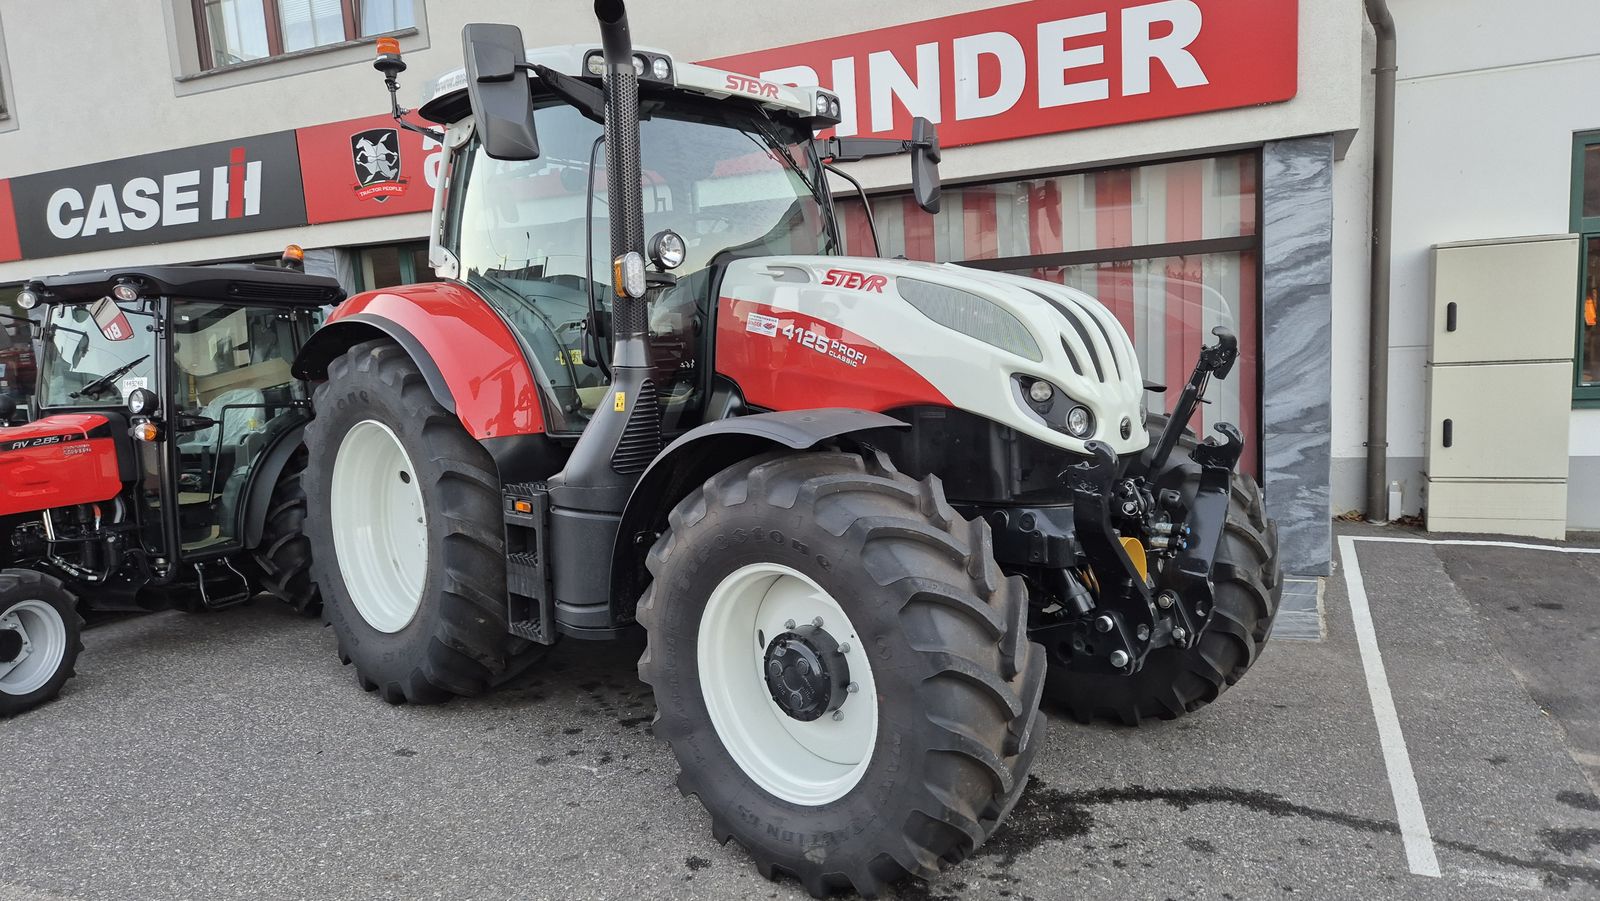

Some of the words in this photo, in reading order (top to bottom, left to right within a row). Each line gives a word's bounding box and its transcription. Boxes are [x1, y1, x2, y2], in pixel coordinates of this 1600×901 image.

[725, 73, 780, 101] STEYR
[46, 170, 200, 239] CASE
[359, 187, 382, 197] TRACTOR
[821, 268, 888, 294] STEYR
[782, 324, 830, 354] 4125
[830, 341, 868, 365] PROFI
[828, 350, 858, 368] CLASSIC
